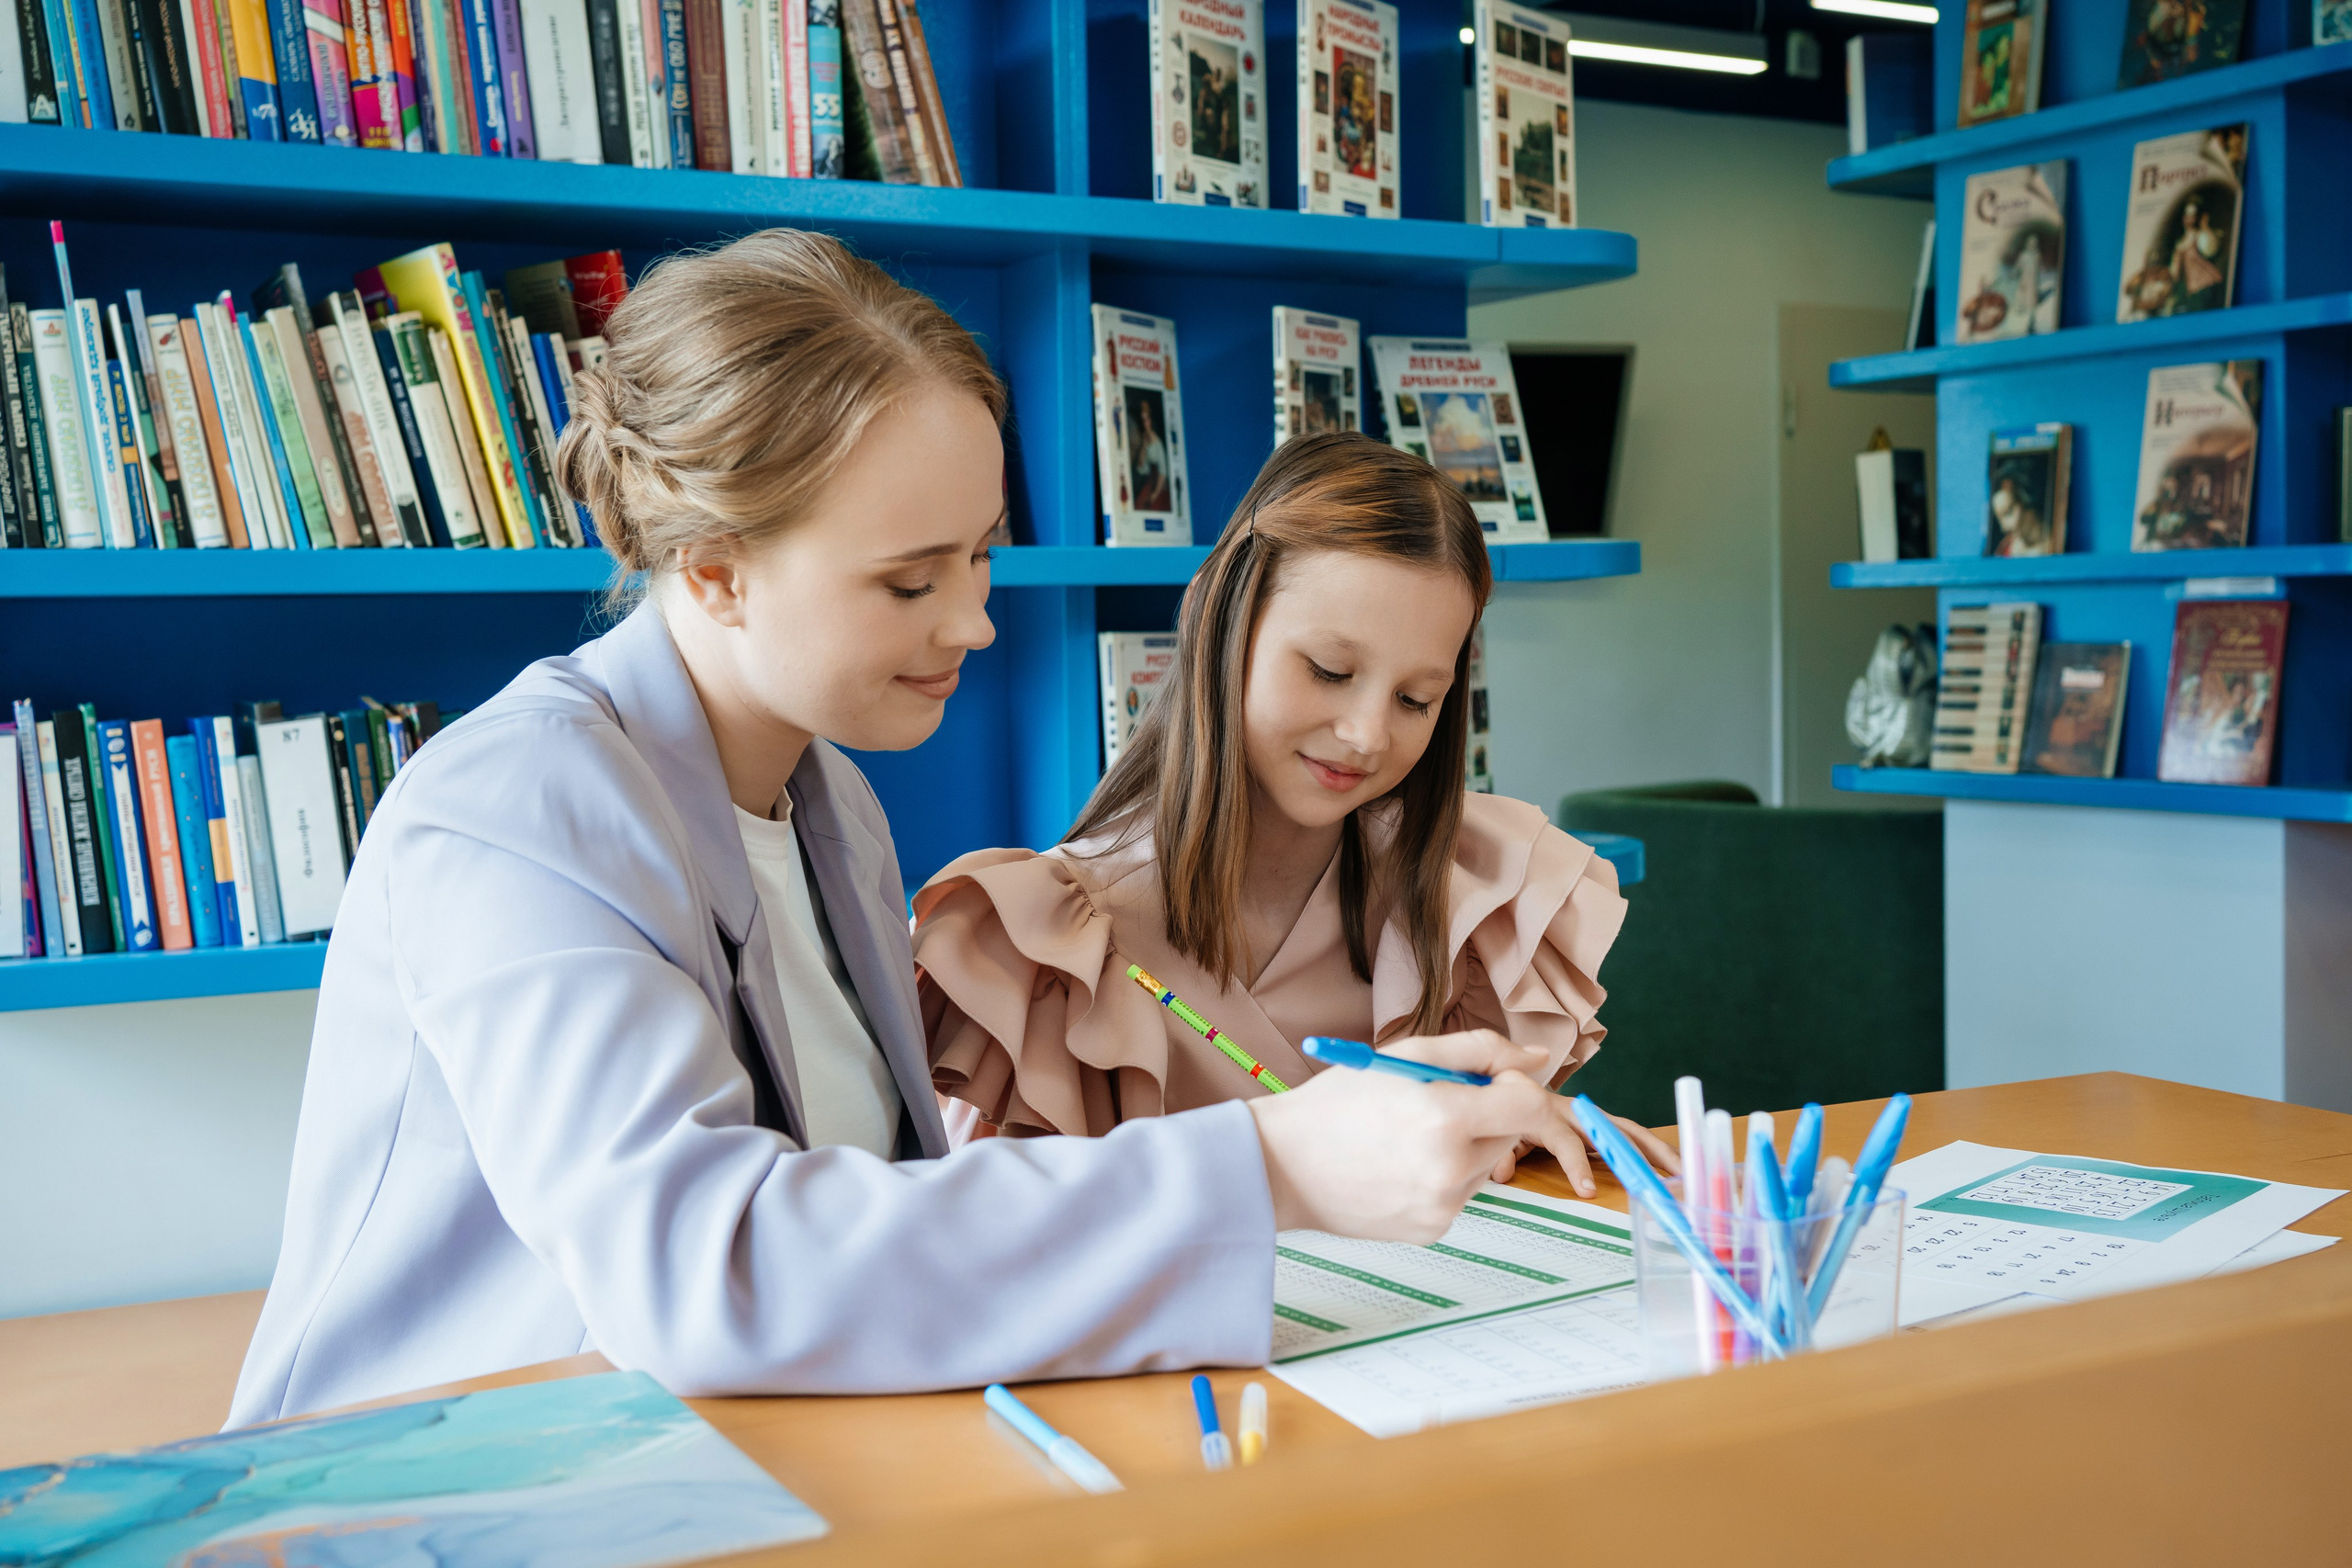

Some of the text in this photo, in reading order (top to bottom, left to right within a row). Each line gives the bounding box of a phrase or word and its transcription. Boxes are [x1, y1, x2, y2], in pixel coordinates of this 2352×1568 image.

[1179, 9, 1246, 40] КАЛЕНДАРЬ
[1118, 334, 1160, 355] РУССКИЙ
[1120, 354, 1161, 373] КОСТЮМ
[1408, 355, 1482, 372] ЛЕГЕНДЫ
[23, 364, 39, 420] ИСКУССТВА
[49, 373, 75, 412] МИР
[164, 368, 193, 412] МИР
[1400, 375, 1497, 388] ДРЕВНЕЙ РУСИ
[10, 399, 28, 448] СКОРО
[55, 418, 85, 493] ПОЗНАЮ
[175, 416, 214, 500] ПОЗНАЮ
[283, 728, 300, 744] 87
[145, 748, 162, 781] РУСИ
[298, 809, 314, 879] Философия
[2058, 1170, 2087, 1179] 20
[2091, 1209, 2121, 1217] 13
[2106, 1201, 2137, 1210] 21
